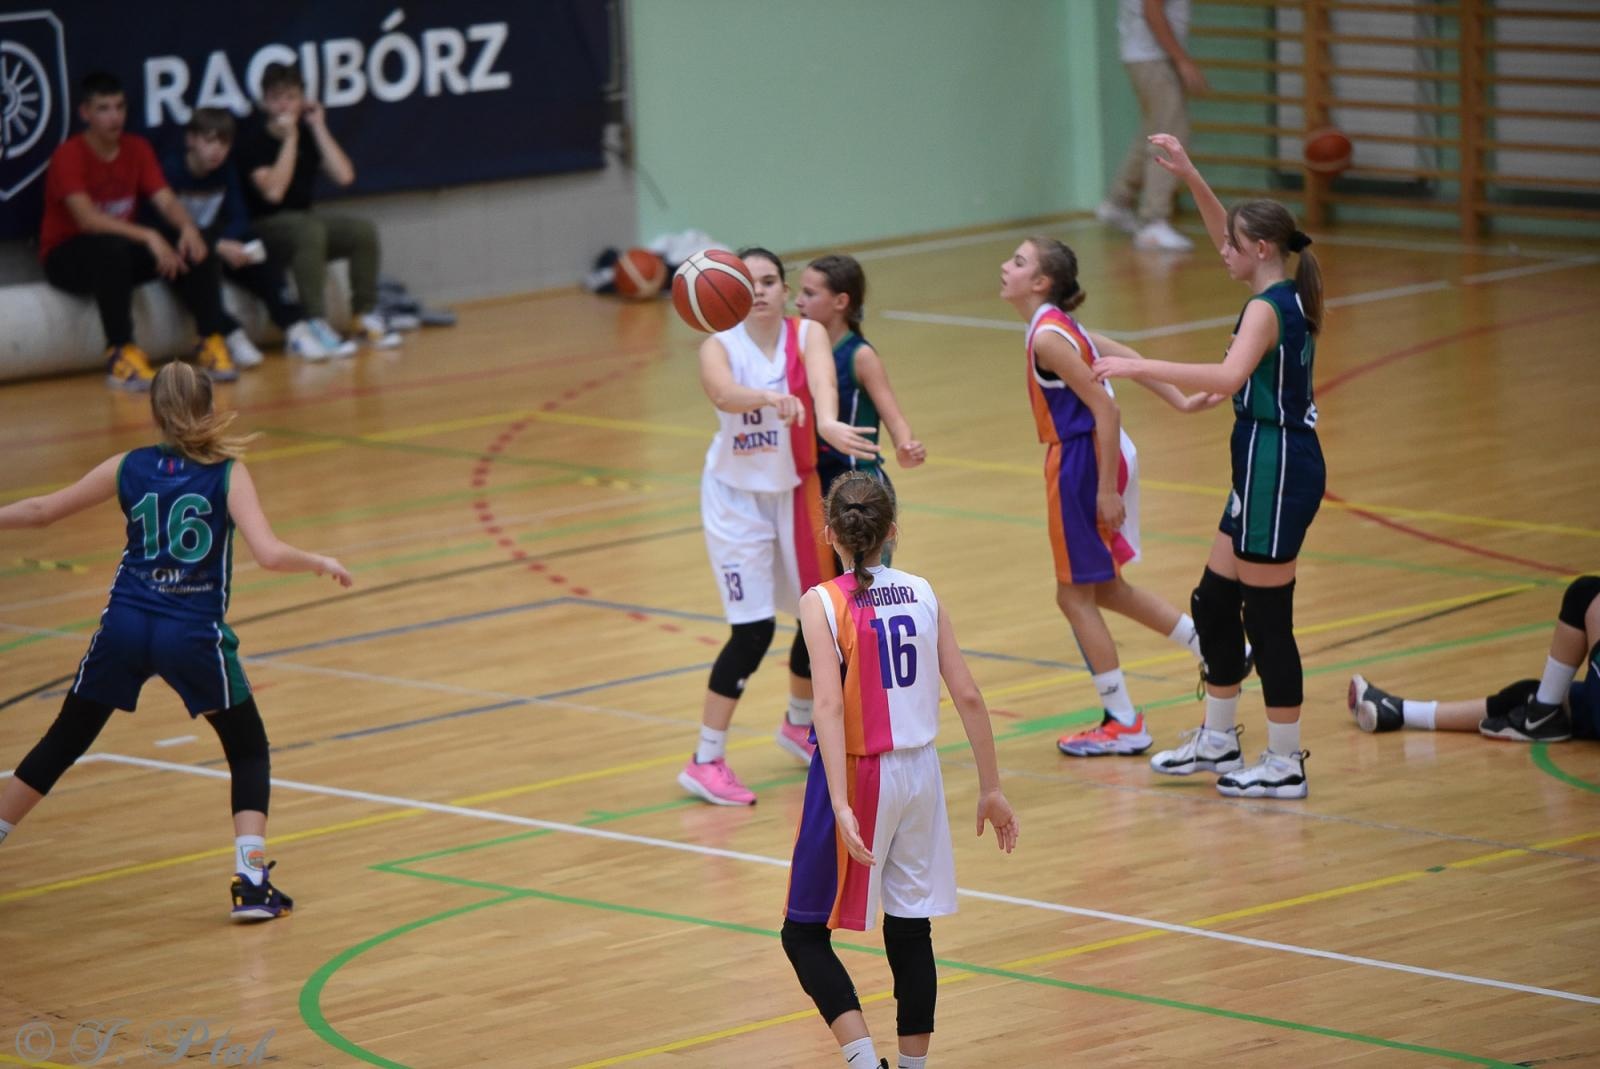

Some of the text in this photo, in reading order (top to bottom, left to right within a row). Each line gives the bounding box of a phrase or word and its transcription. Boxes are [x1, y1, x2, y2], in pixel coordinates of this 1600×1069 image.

[143, 9, 511, 127] RACIBÓRZ
[733, 430, 778, 449] MINI
[131, 492, 213, 563] 16
[724, 571, 743, 602] 13
[854, 583, 918, 608] RACIBÓRZ
[870, 615, 917, 689] 16
